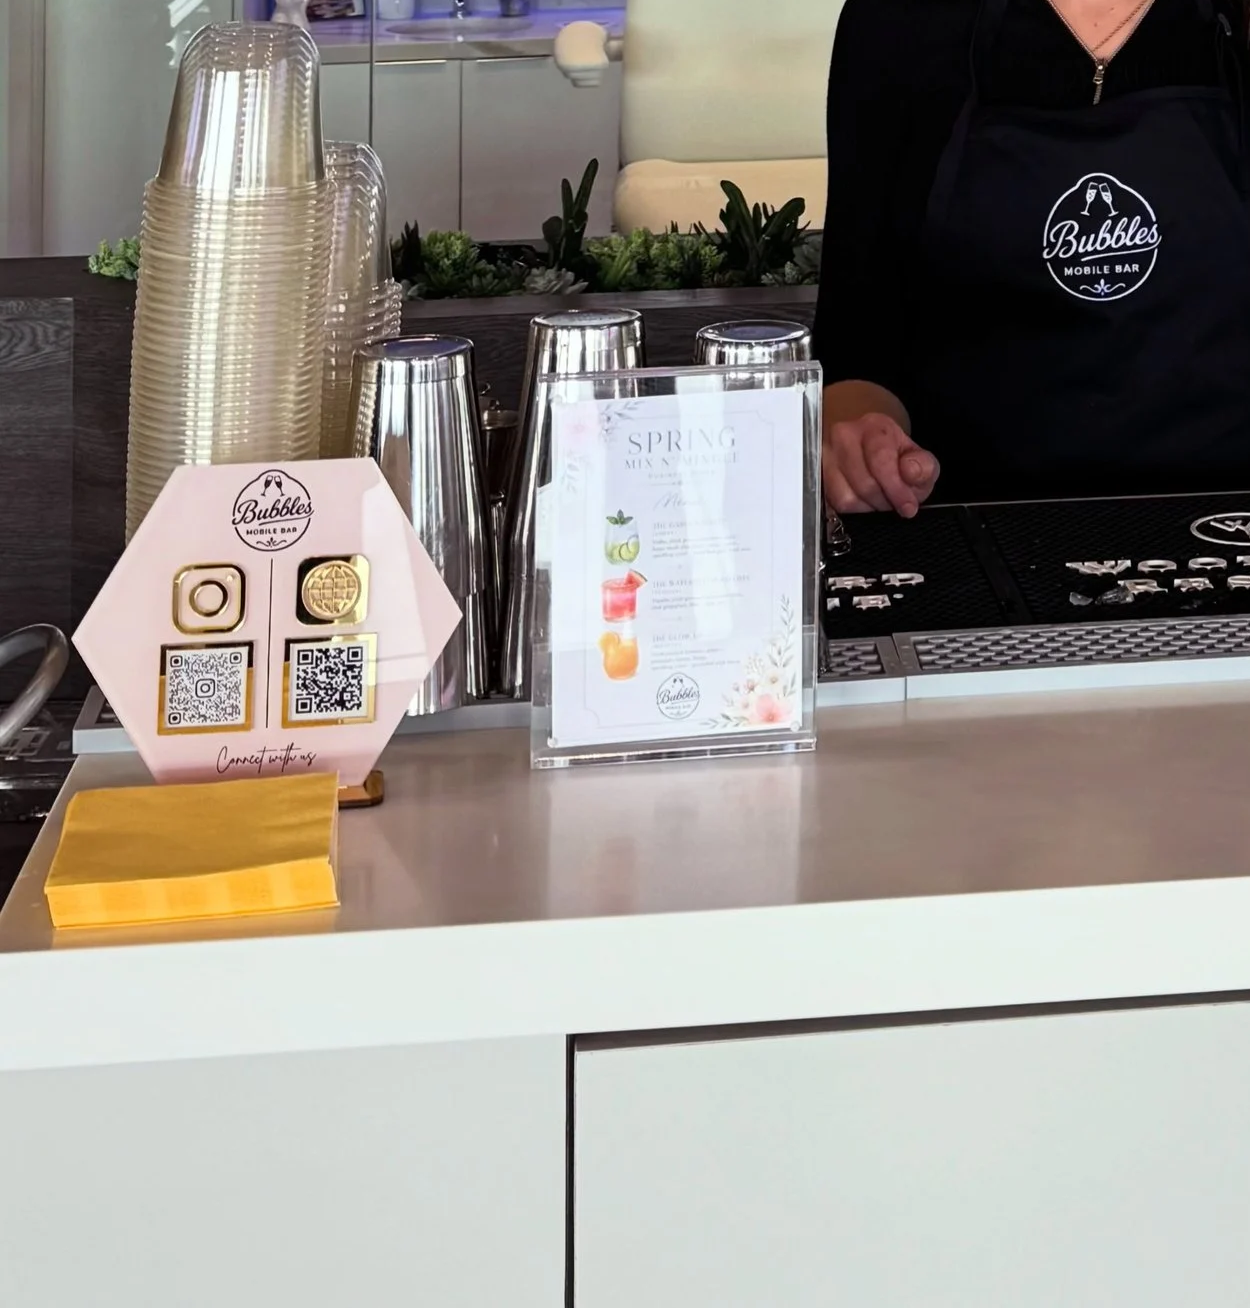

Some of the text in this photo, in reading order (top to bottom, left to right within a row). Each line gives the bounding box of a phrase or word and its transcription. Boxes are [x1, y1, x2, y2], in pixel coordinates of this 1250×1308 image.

[1043, 216, 1159, 259] Bubbles
[1064, 264, 1139, 276] MOBILE BAR
[628, 426, 736, 455] SPRING
[624, 458, 653, 470] MIX
[232, 496, 313, 525] Bubbles
[216, 742, 317, 774] Connect with us
